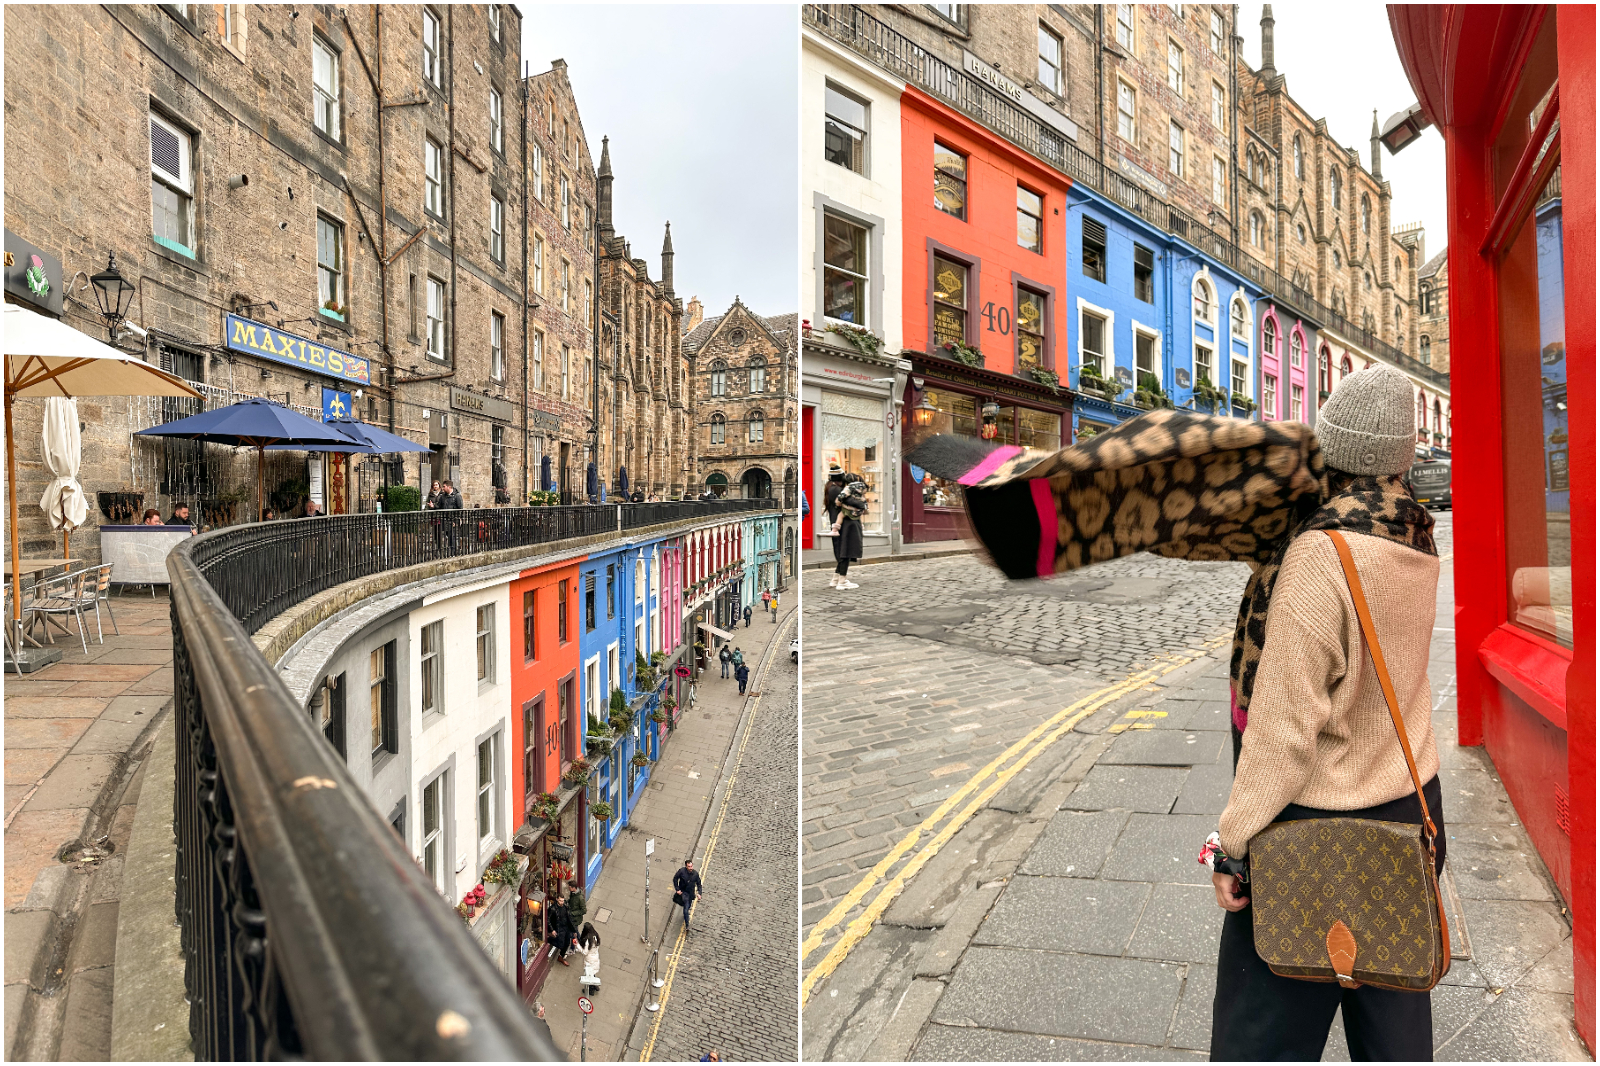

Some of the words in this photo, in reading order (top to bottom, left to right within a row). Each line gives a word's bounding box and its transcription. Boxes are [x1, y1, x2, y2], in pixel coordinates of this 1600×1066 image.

[971, 59, 1022, 100] HANAMS
[980, 301, 1011, 336] 40
[1023, 306, 1036, 317] BEST
[232, 320, 344, 373] MAXIES
[1021, 342, 1037, 363] 2
